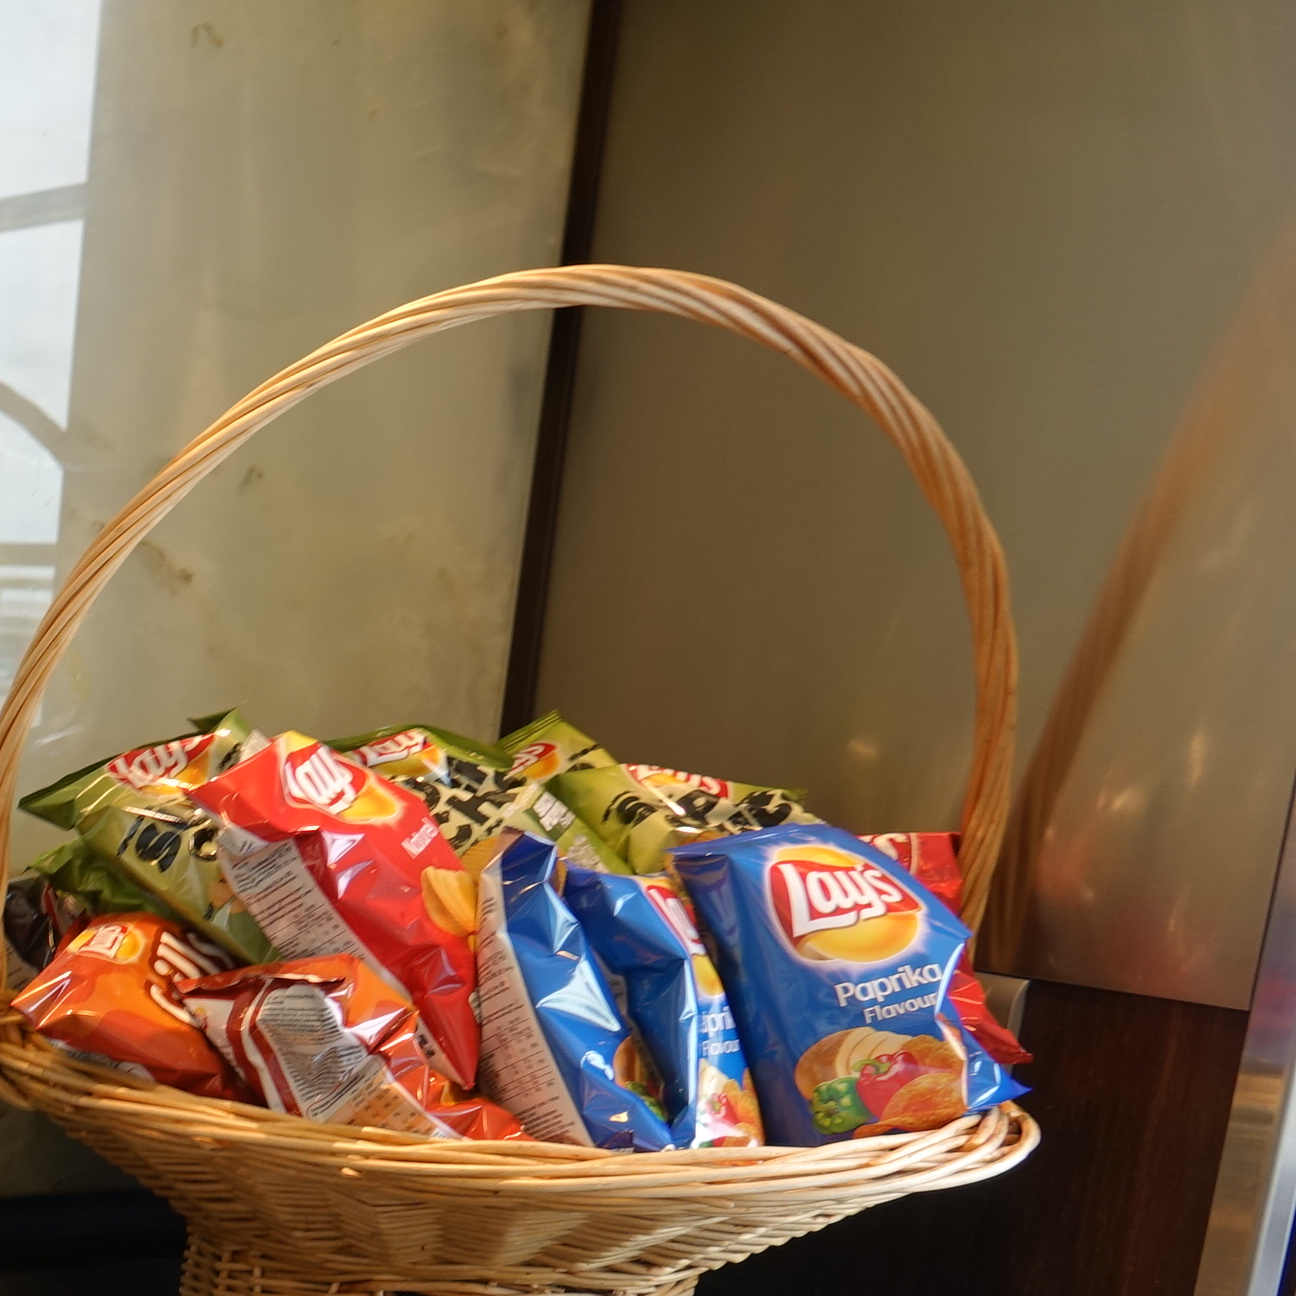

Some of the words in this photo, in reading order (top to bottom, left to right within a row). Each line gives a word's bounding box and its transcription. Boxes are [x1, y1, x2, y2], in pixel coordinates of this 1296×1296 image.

[777, 863, 903, 938] Lay's
[834, 962, 943, 1007] Paprika
[863, 992, 938, 1025] Flavour
